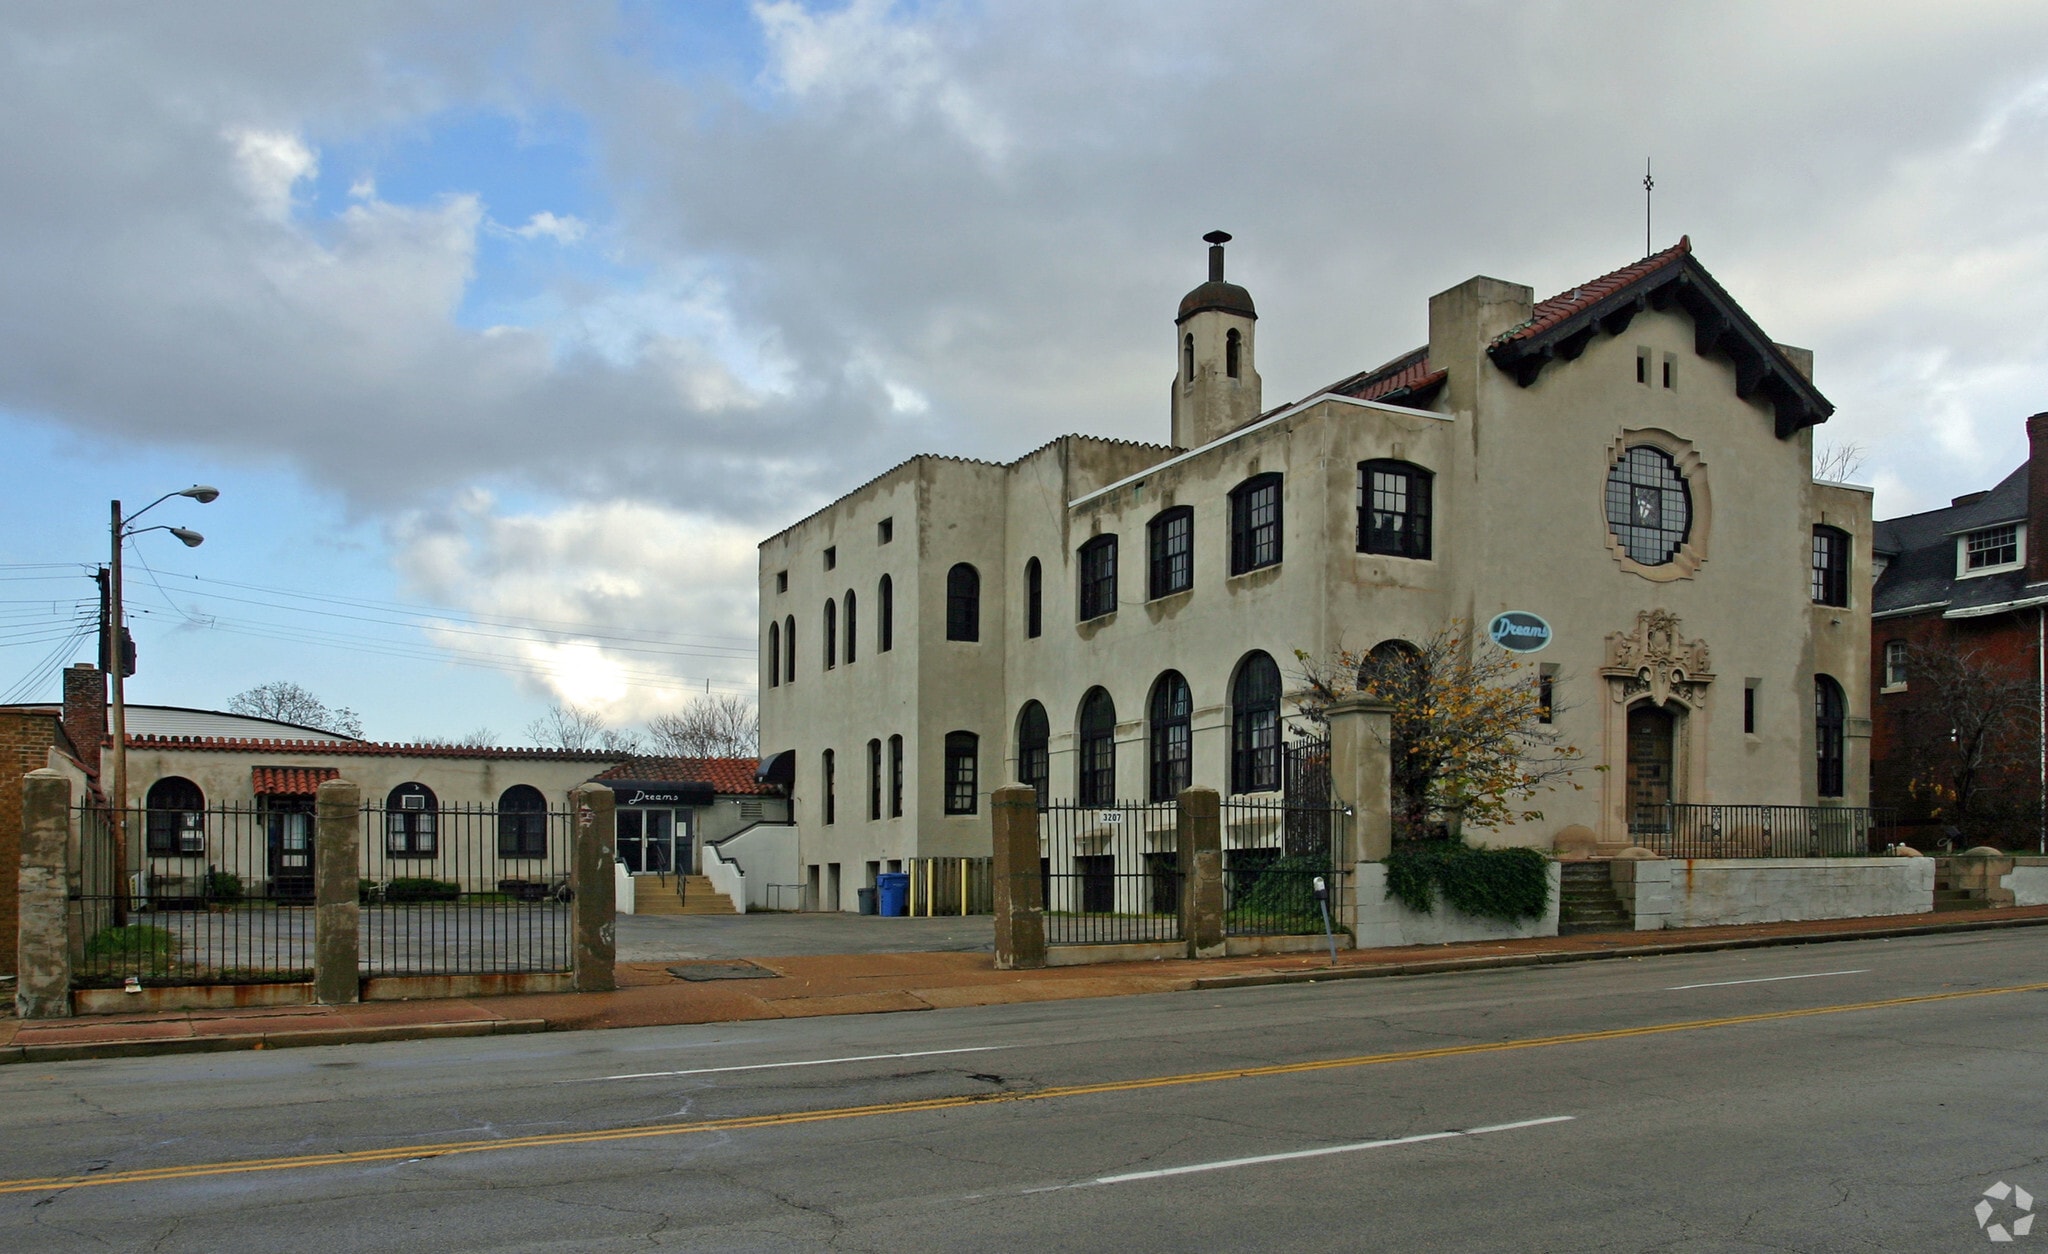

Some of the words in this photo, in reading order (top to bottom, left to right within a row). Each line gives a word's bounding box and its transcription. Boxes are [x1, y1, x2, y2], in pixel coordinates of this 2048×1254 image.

[1492, 617, 1548, 641] Dreams
[628, 790, 679, 805] Dreams
[1103, 813, 1121, 822] 3207
